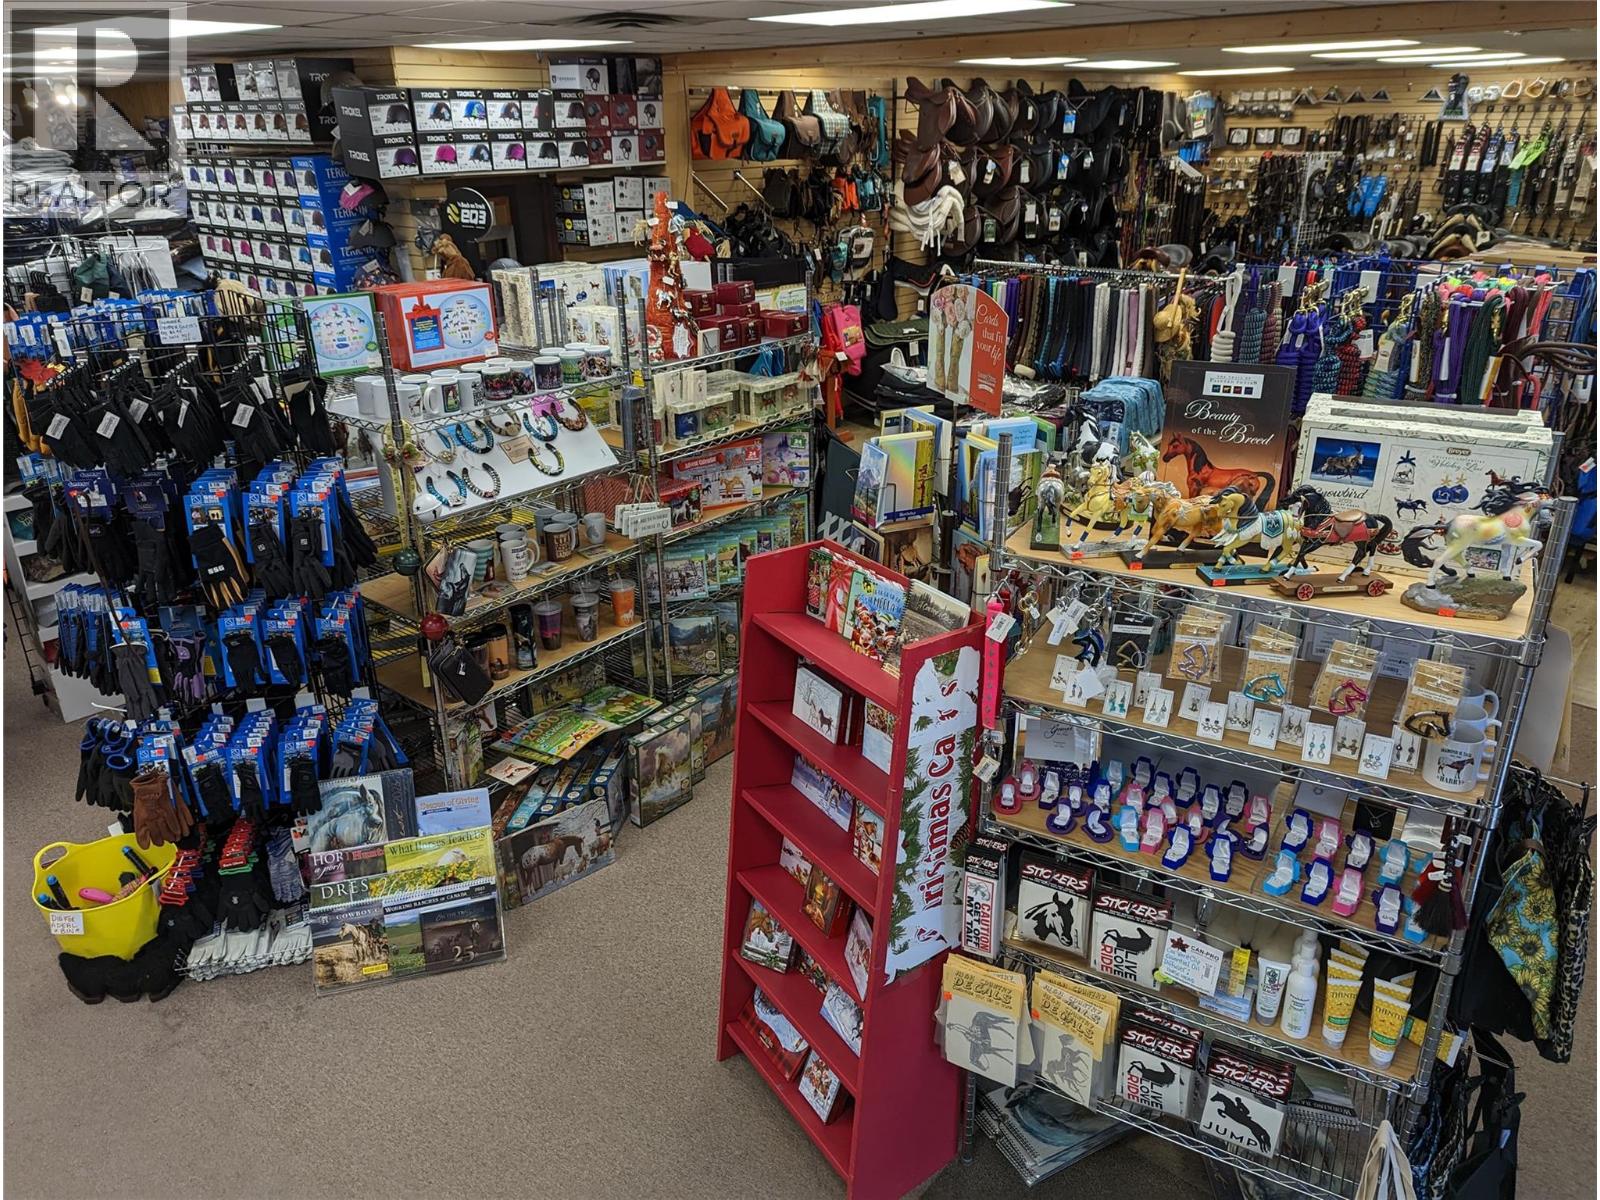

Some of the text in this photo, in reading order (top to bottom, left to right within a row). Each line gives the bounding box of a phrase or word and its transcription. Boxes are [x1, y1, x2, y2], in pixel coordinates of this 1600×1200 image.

[1184, 398, 1241, 426] Beauty
[1203, 427, 1217, 436] the
[1219, 422, 1275, 446] Breed
[207, 564, 225, 576] SSG
[522, 714, 561, 742] 2000
[389, 843, 414, 856] What
[976, 837, 1008, 852] STICKERS
[312, 851, 343, 867] HOR
[966, 855, 999, 870] STICKERS
[321, 878, 369, 899] DRES
[1022, 864, 1089, 891] STICKERS
[966, 895, 974, 916] MY
[1096, 895, 1169, 921] STICKERS
[972, 901, 981, 948] GET OFF
[980, 903, 992, 953] CAUTION
[453, 945, 476, 963] 25
[1100, 943, 1113, 975] RIDE
[1113, 946, 1125, 979] LOVE
[1124, 949, 1138, 982] LIVE
[1190, 945, 1220, 961] CAN-PRO
[952, 976, 1013, 1005] DECALS
[1123, 1030, 1193, 1059] STICKERS
[1127, 1072, 1140, 1104] RIDE
[1139, 1076, 1151, 1107] LOVE
[1211, 1063, 1285, 1096] STICKERS
[1150, 1081, 1164, 1111] LIVE
[1202, 1121, 1259, 1148] JUMP
